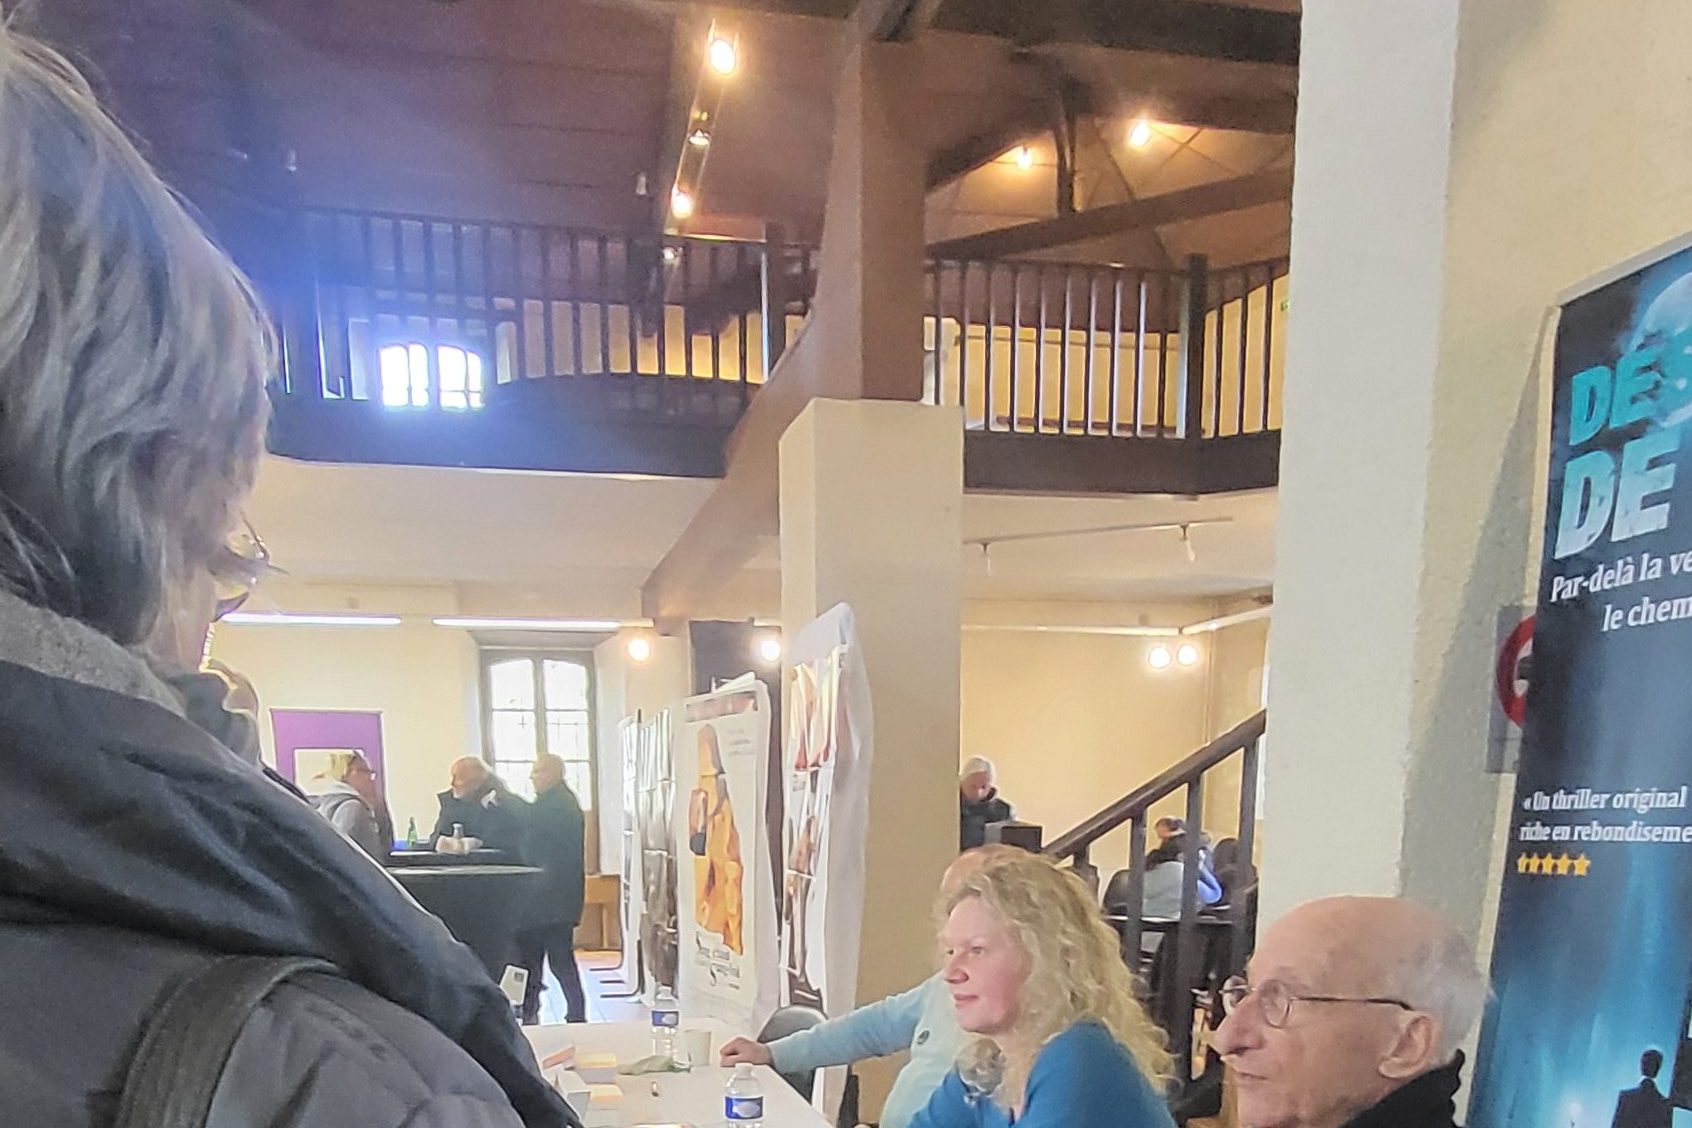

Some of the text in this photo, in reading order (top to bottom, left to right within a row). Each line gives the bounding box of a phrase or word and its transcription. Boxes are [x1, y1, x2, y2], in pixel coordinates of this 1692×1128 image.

[1554, 428, 1680, 560] DE
[1549, 556, 1635, 603] Par-delà
[1639, 552, 1662, 581] la
[1602, 604, 1624, 632] le
[1551, 788, 1611, 810] thriller
[1612, 785, 1688, 814] original
[1552, 825, 1571, 841] en
